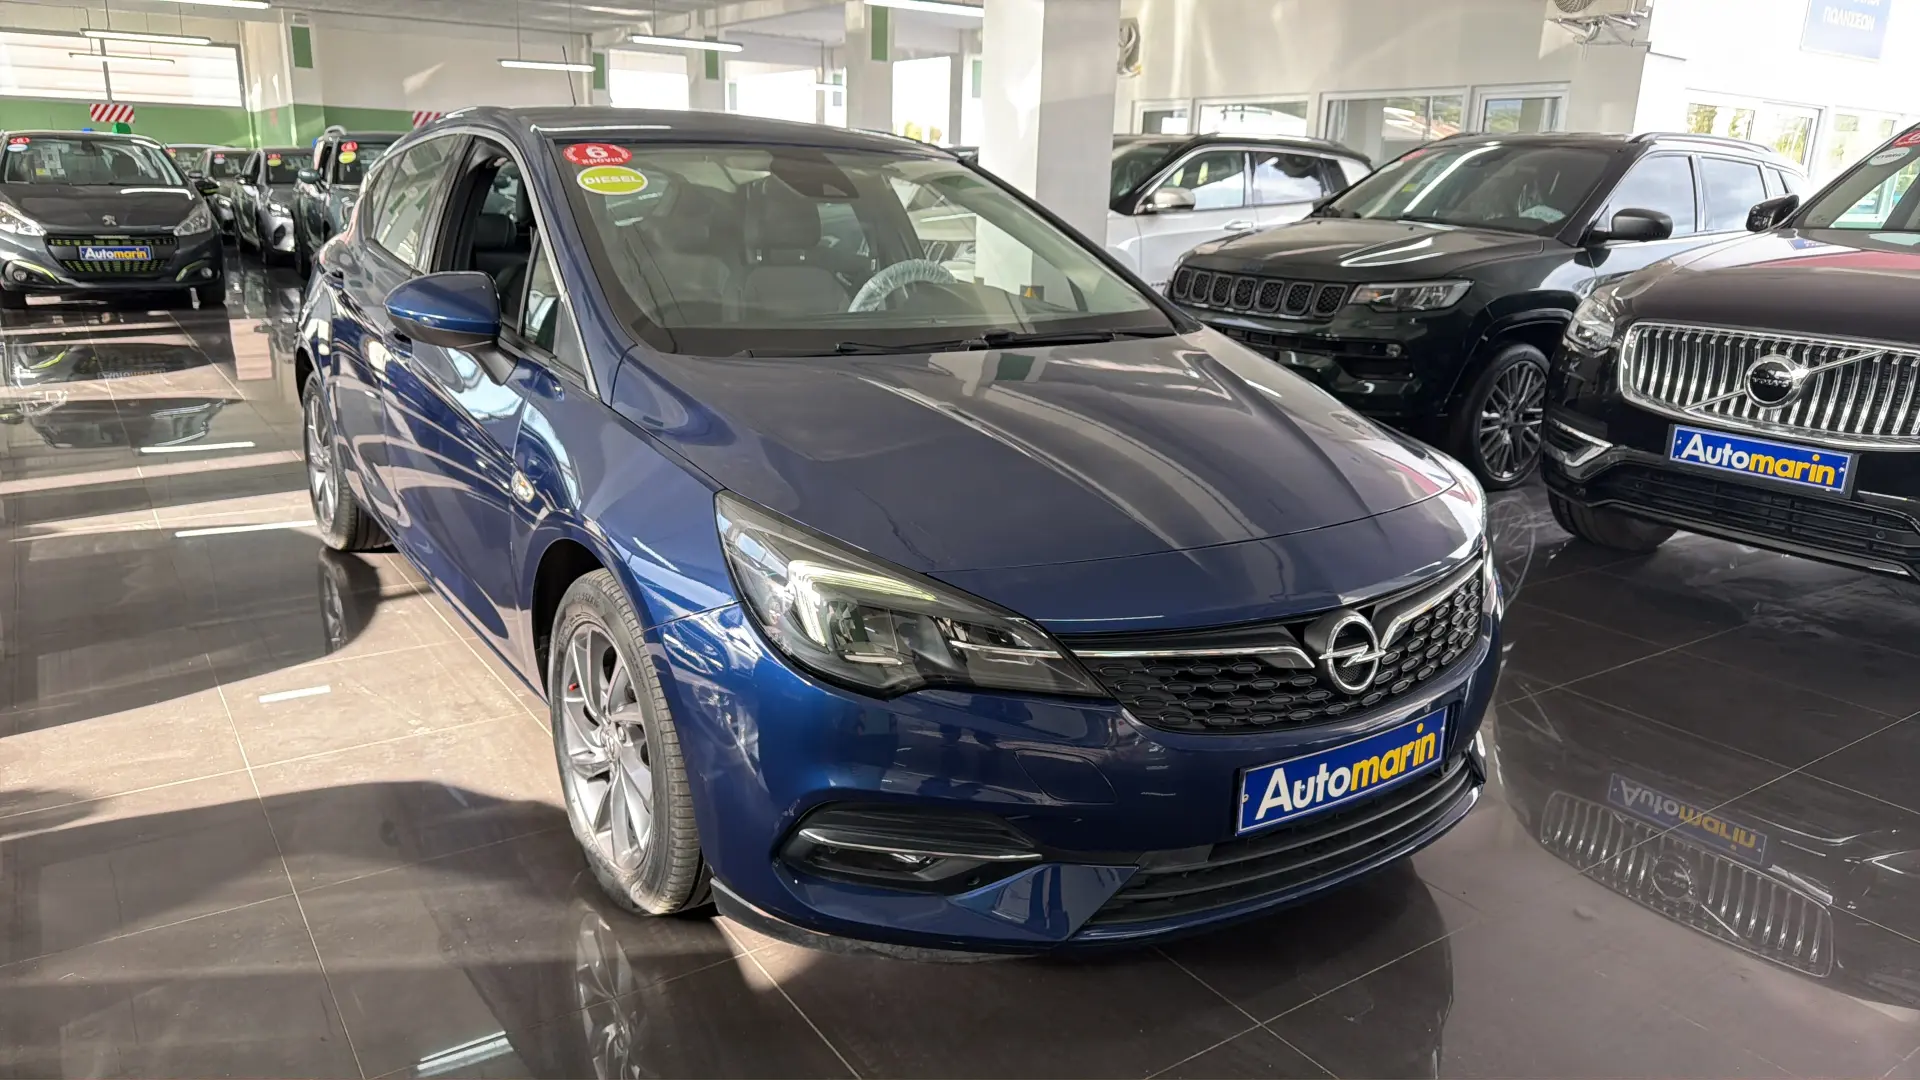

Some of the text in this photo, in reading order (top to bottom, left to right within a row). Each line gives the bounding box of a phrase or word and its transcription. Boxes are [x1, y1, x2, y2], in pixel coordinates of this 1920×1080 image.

[584, 176, 641, 184] DIESEL
[85, 248, 147, 259] Automarin
[1681, 433, 1836, 486] Automarin
[1255, 722, 1436, 821] Automarin
